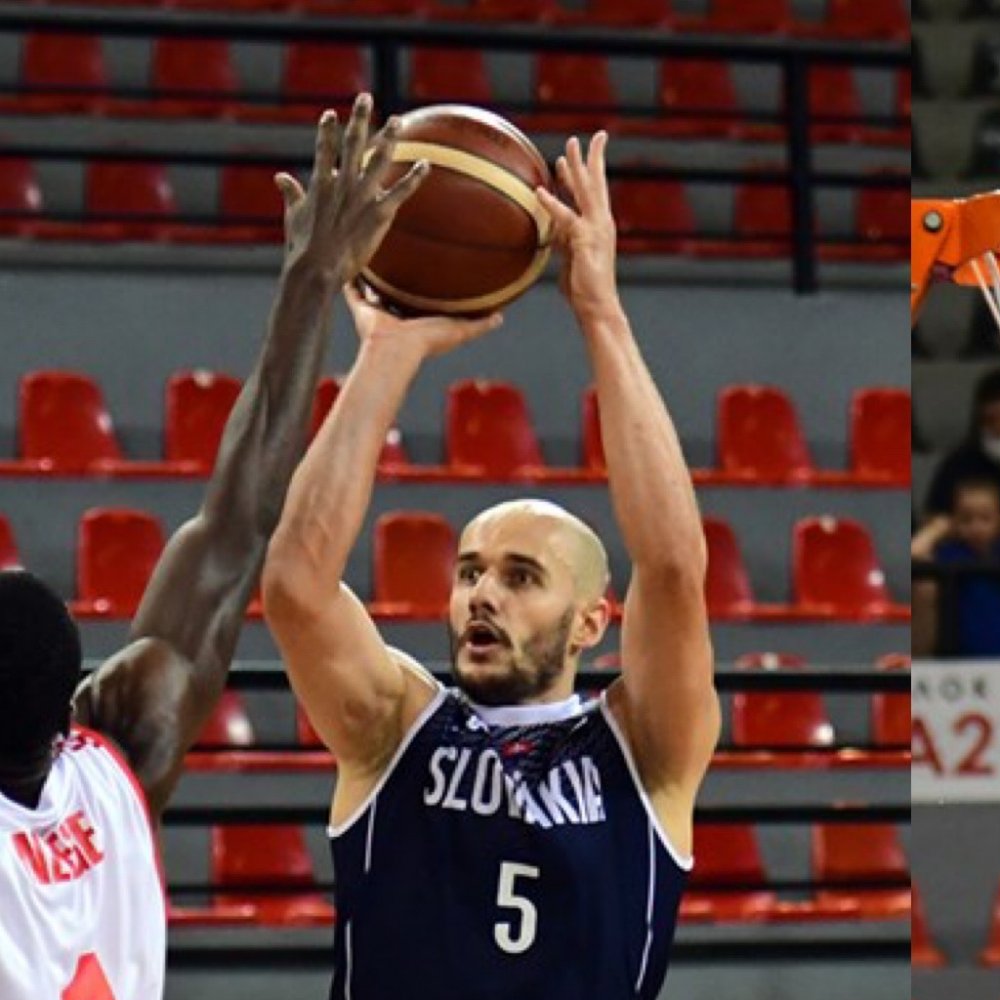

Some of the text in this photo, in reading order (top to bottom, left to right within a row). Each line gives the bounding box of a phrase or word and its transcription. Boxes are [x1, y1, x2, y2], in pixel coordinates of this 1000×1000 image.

[911, 711, 996, 777] A2
[423, 746, 606, 828] SLOVAKIA
[495, 861, 540, 954] 5
